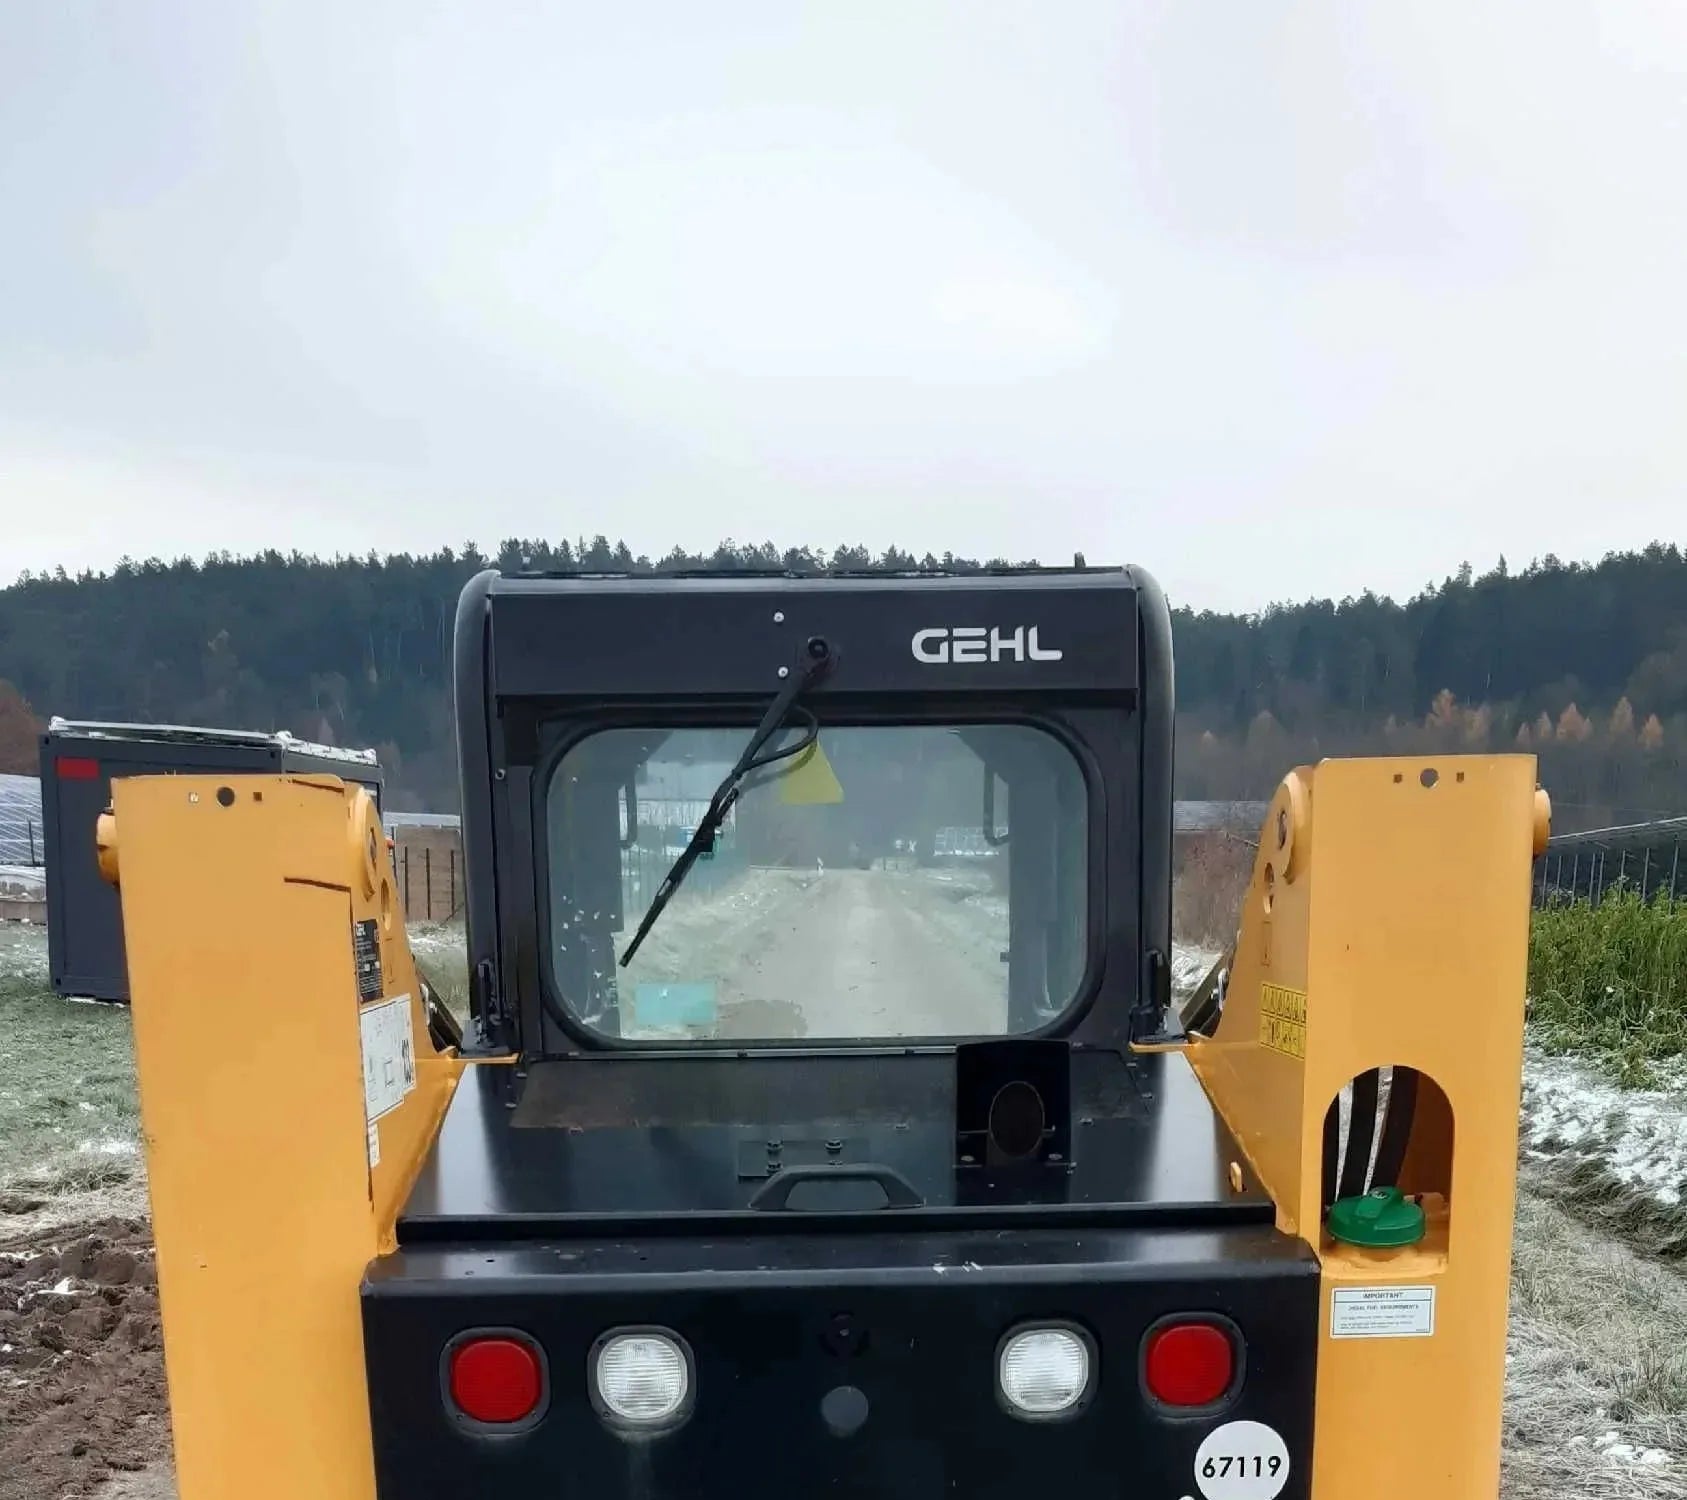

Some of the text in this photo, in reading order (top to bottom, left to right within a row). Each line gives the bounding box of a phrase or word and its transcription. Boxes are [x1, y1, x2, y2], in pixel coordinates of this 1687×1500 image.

[911, 624, 1063, 664] GEHL
[1362, 1291, 1404, 1299] IMPORTANT
[1202, 1455, 1282, 1478] 67119
